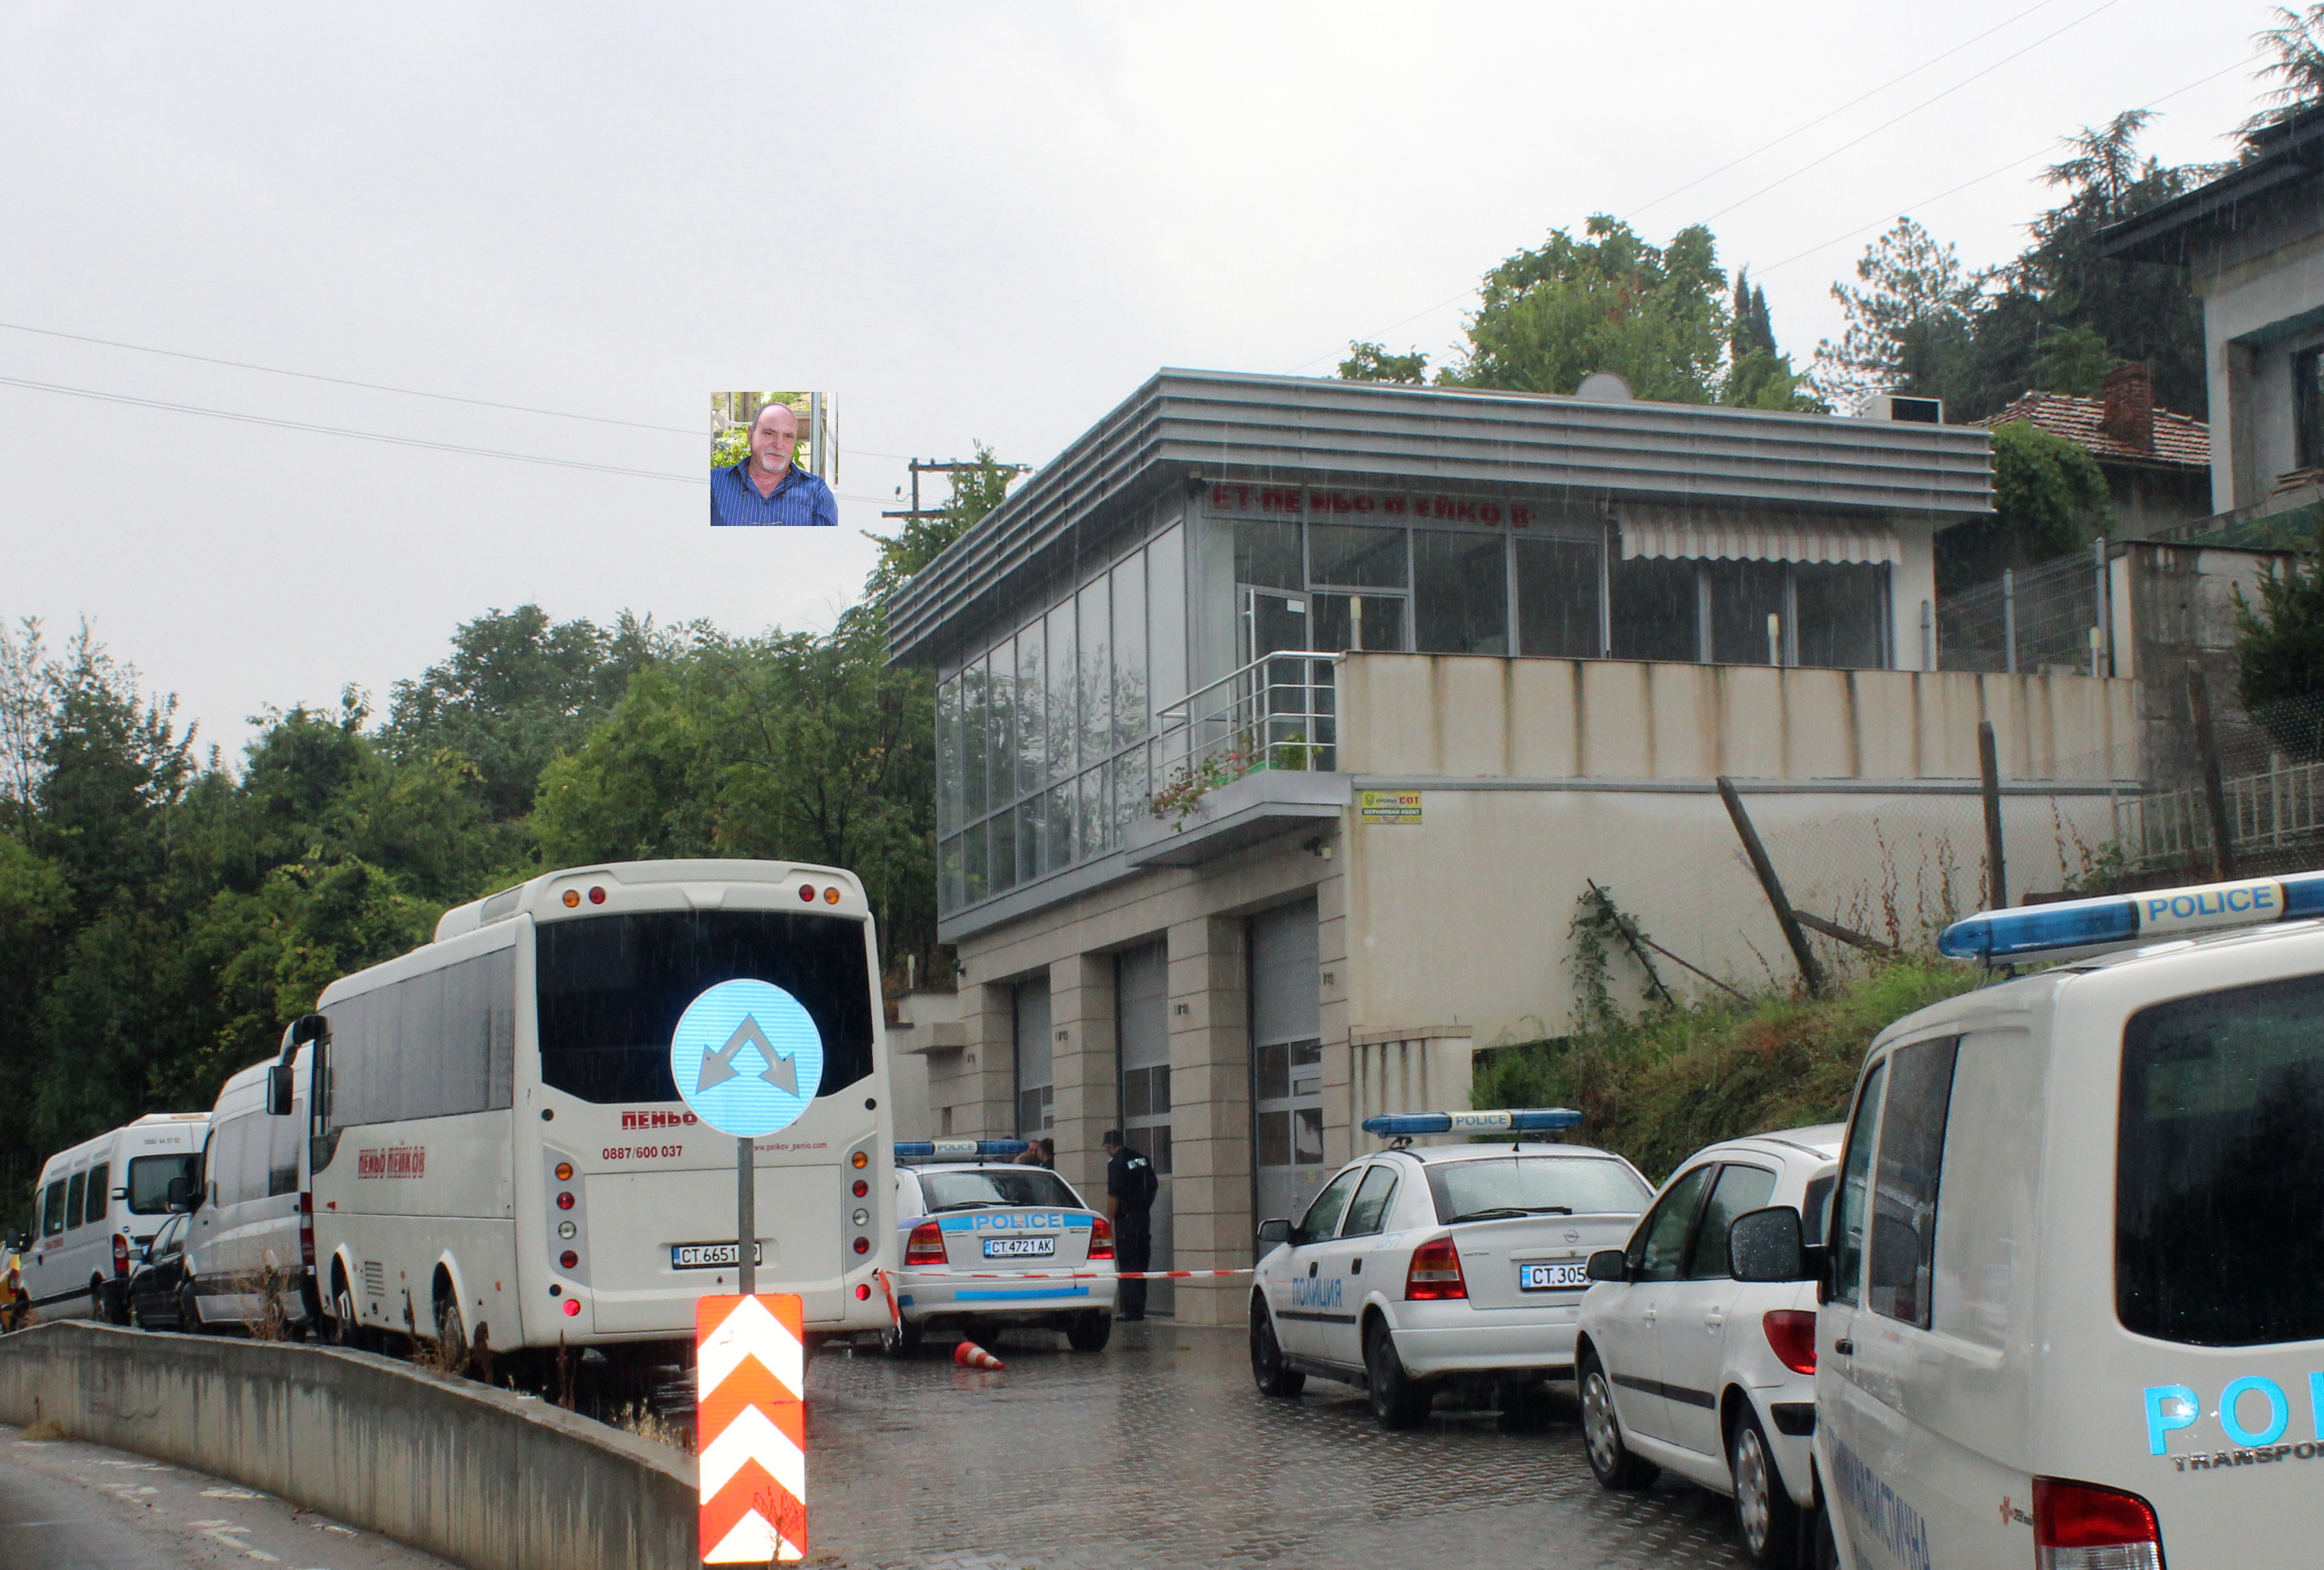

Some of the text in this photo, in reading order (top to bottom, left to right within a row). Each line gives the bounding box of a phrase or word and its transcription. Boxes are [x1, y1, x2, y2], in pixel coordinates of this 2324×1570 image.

[1399, 796, 1418, 804] СОТ
[2148, 886, 2274, 921] POLICE
[622, 1110, 698, 1130] ПЕНЬО
[1456, 1114, 1508, 1125] POLICE
[602, 1145, 683, 1159] 0887/600 037
[937, 1143, 974, 1151] POLICE
[975, 1213, 1061, 1230] POLICE
[1532, 1267, 1593, 1284] CT.305
[1292, 1277, 1342, 1312] ПОЛИЦИЯ
